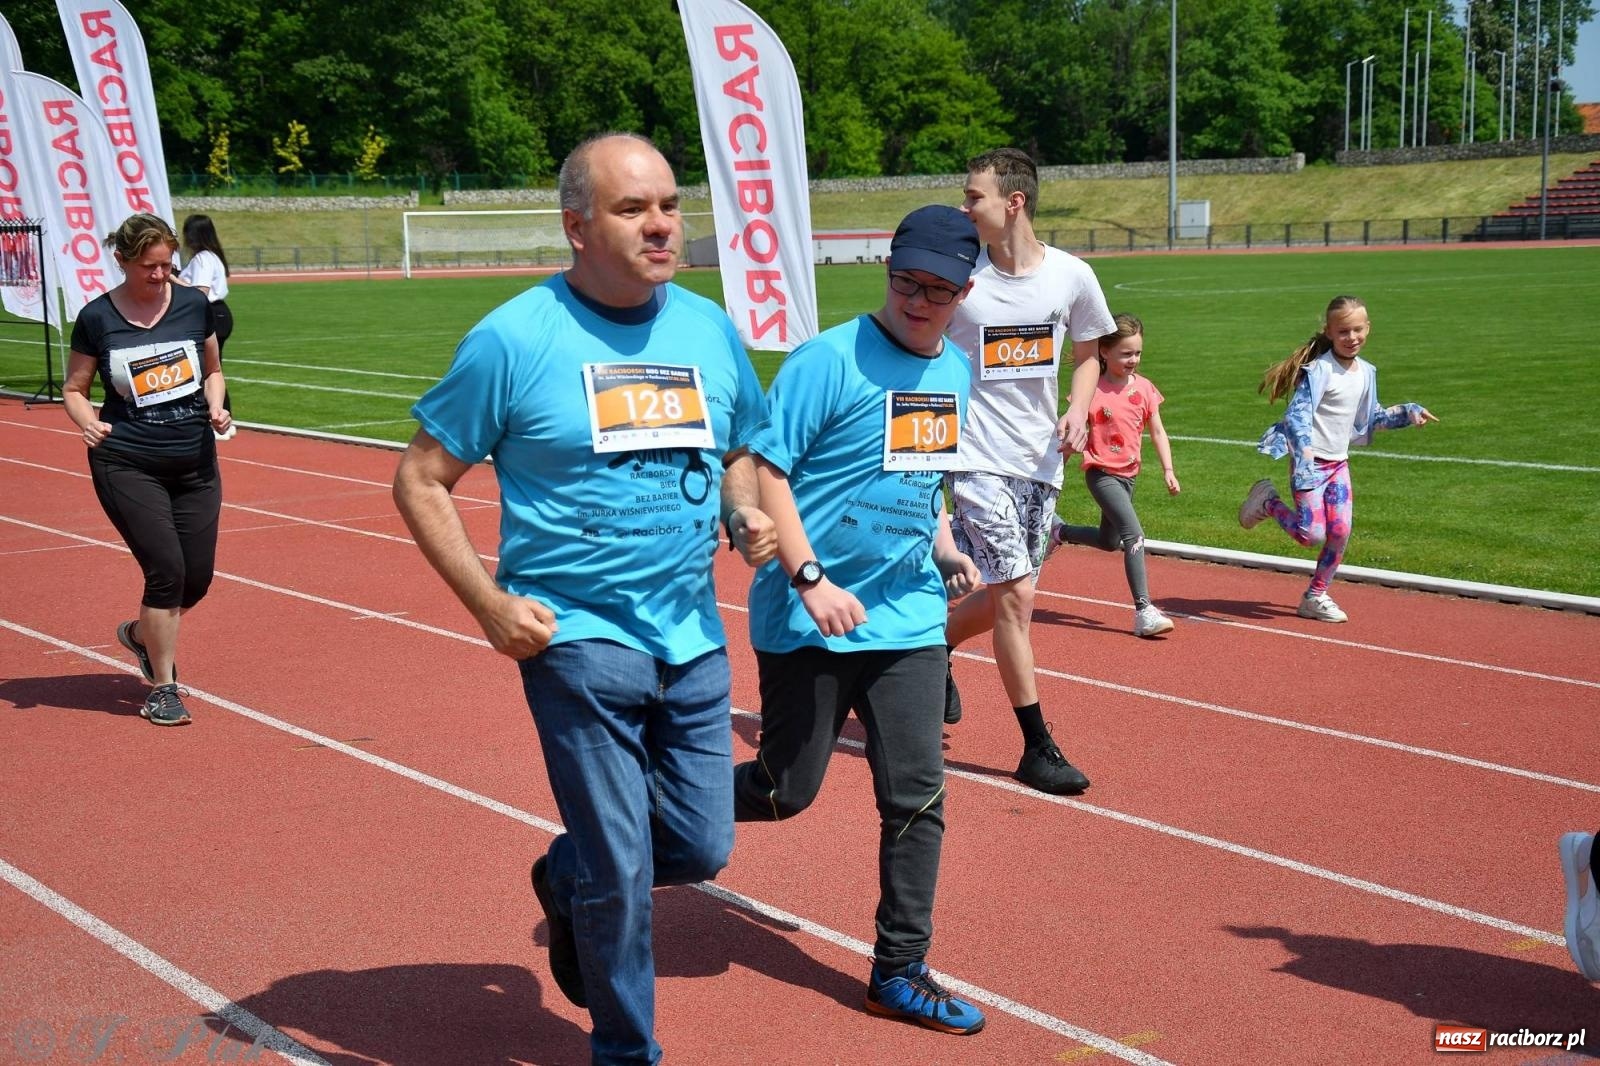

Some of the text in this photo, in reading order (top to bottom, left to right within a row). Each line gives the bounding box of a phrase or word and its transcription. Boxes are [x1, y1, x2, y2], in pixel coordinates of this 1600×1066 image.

[997, 341, 1039, 361] 064
[145, 365, 183, 389] 062
[622, 389, 683, 421] 128
[912, 417, 947, 445] 130
[635, 492, 679, 503] BEZ BARIER
[591, 509, 617, 518] JURKA
[618, 503, 682, 516] WIŚNIEWSKIEGO
[632, 525, 683, 537] Racibórz
